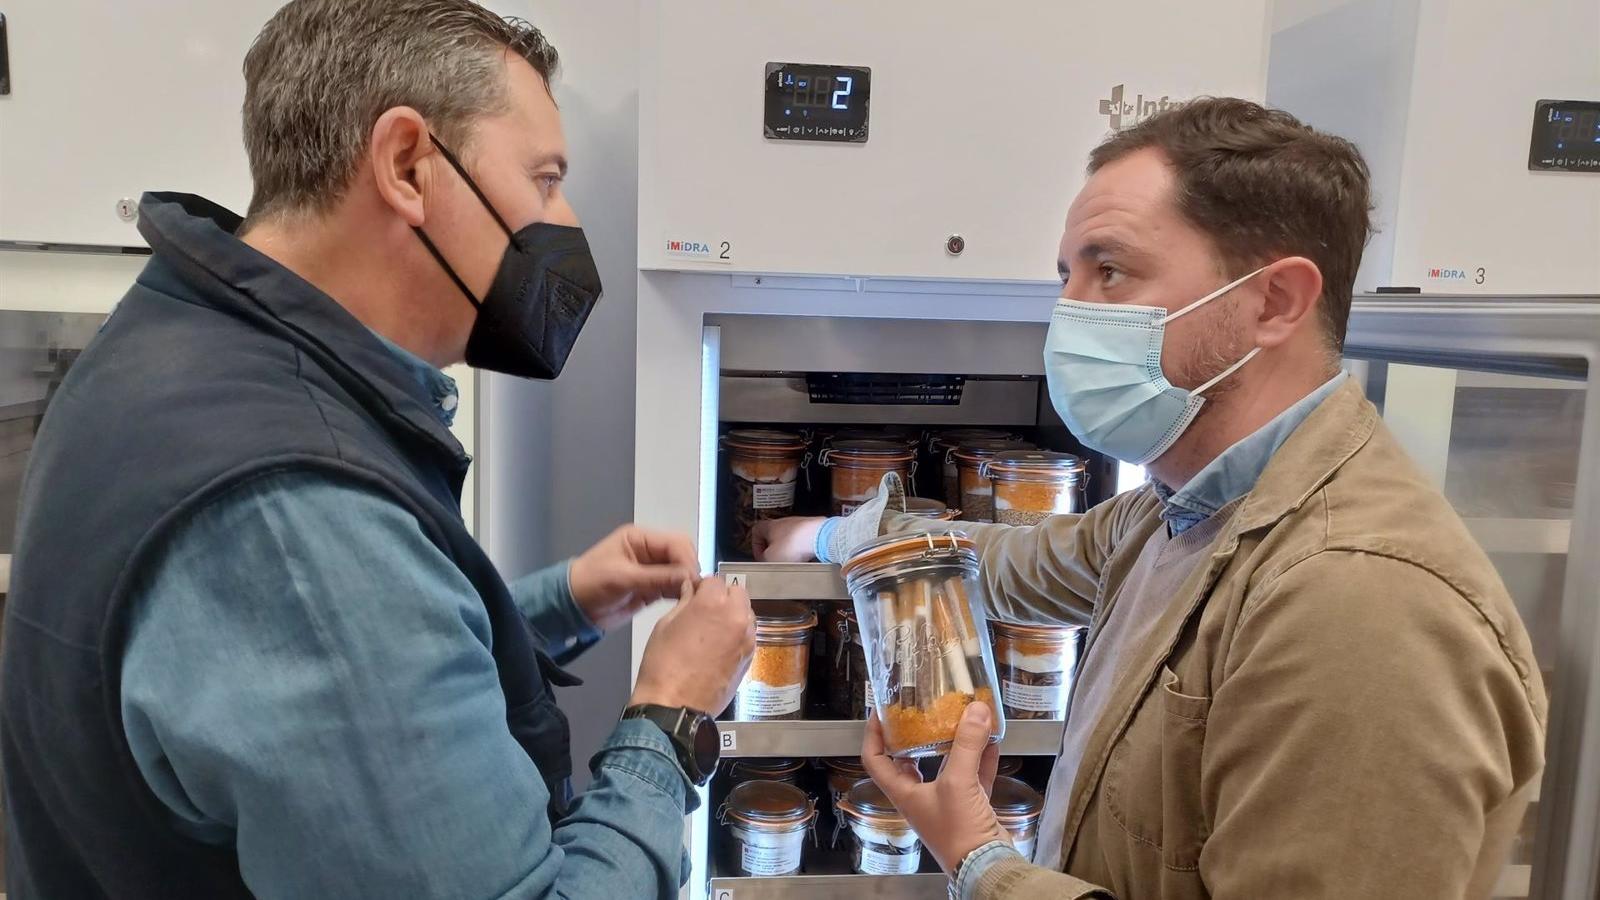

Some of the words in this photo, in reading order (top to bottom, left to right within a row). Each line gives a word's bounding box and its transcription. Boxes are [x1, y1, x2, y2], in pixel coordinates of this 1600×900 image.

[832, 76, 852, 109] 2
[720, 241, 730, 259] 2
[1475, 267, 1486, 285] 3
[723, 734, 732, 747] B
